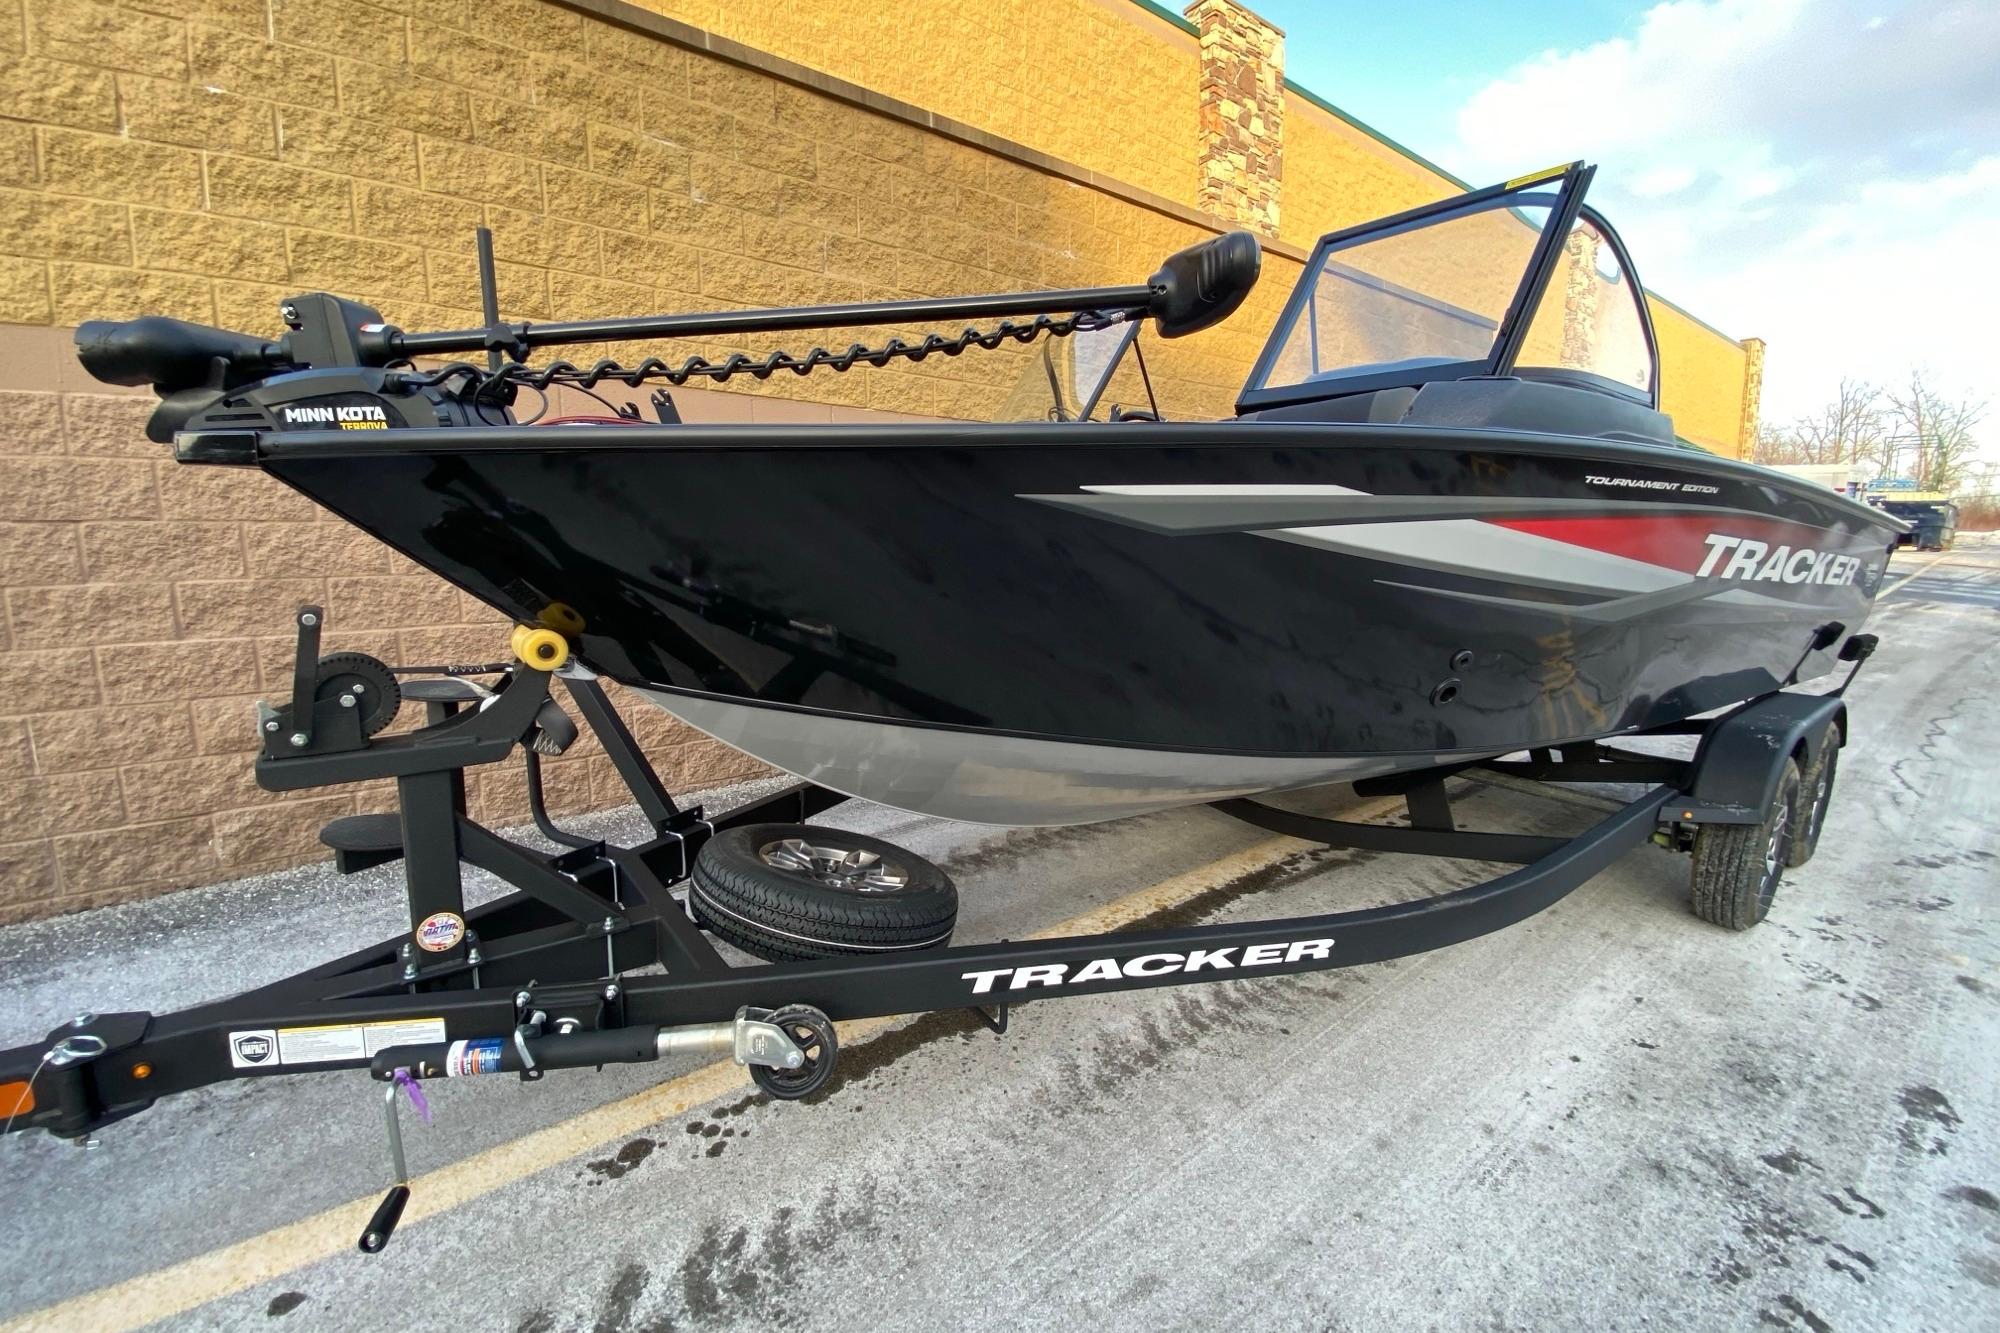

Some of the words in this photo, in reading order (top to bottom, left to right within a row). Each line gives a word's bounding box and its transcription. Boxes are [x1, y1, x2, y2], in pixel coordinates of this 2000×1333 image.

[285, 407, 334, 422] MINN
[336, 406, 387, 421] KOTA
[1585, 475, 1679, 490] TOURNAMENT
[1681, 483, 1720, 494] EDITION
[1695, 533, 1862, 587] TRACKER
[961, 938, 1336, 995] TRACKER
